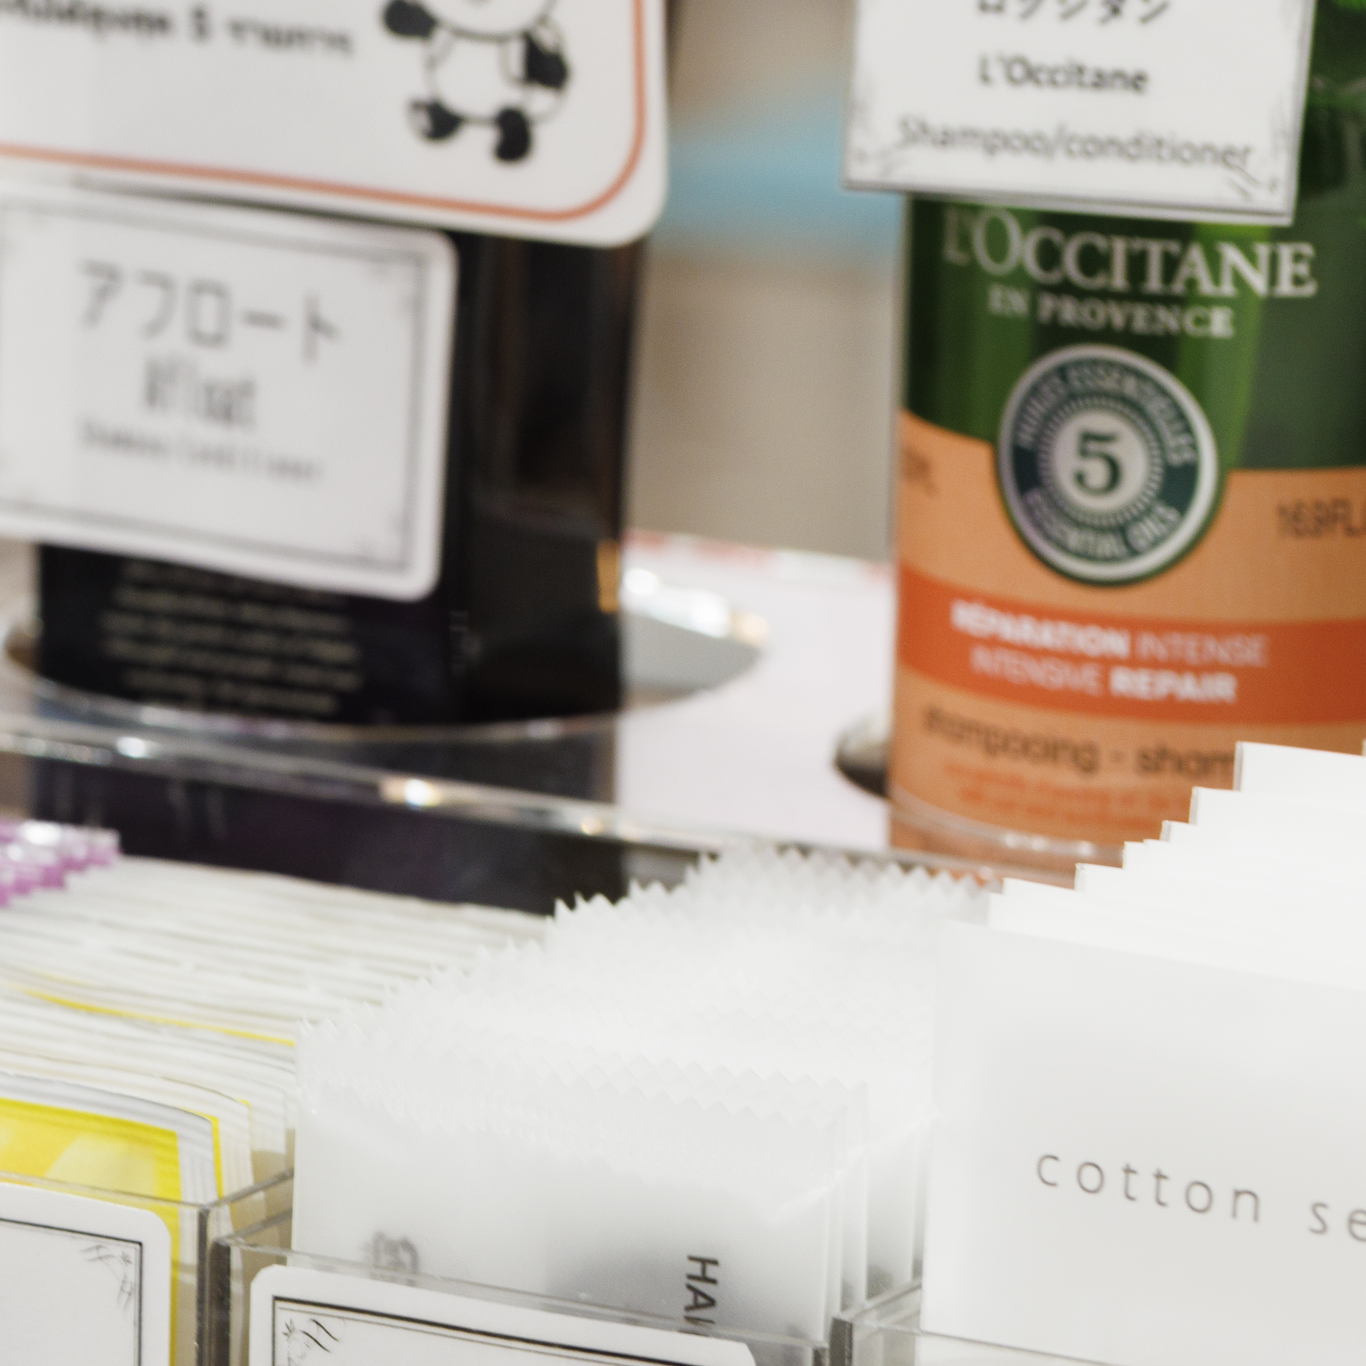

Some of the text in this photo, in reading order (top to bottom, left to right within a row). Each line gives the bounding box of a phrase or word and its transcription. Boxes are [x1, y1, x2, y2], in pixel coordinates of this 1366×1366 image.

[979, 54, 1149, 94] L'Occitane
[899, 117, 1254, 169] Shampoo/conditioner
[945, 208, 1316, 298] L'OCCITANE
[78, 257, 341, 367] アフロート
[1039, 295, 1234, 339] PROVENCE
[1074, 431, 1121, 496] 5
[1037, 1152, 1261, 1224] cotton
